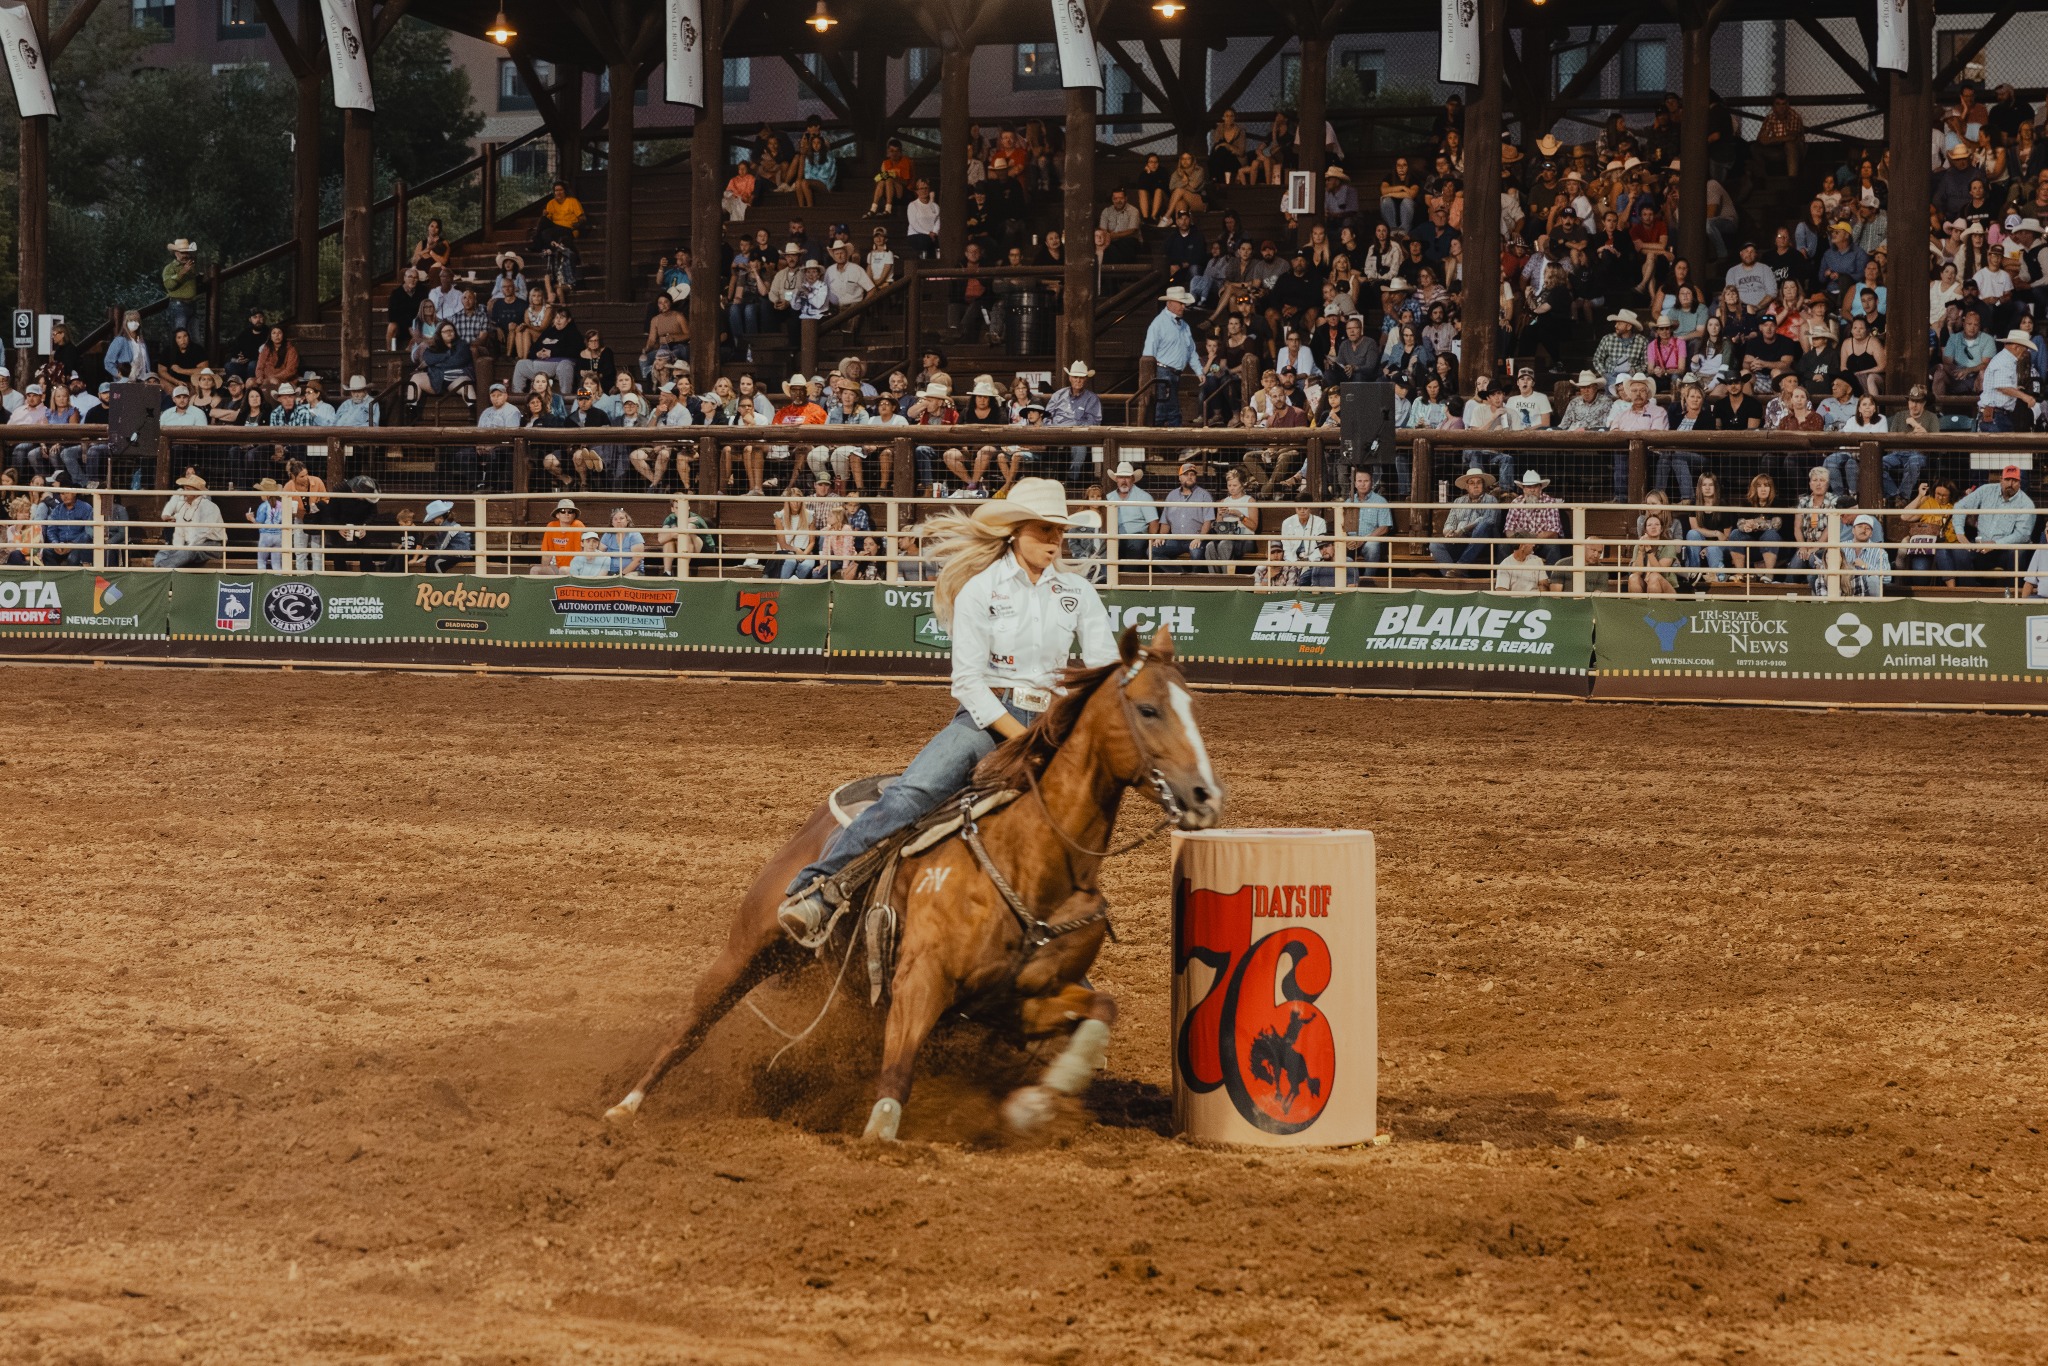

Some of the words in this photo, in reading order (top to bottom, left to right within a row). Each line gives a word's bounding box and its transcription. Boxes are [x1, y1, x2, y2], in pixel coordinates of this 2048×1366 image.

[0, 580, 62, 609] OTA
[271, 584, 318, 600] COWBOY
[415, 582, 510, 613] Rocksino
[559, 588, 586, 598] BUTTE
[587, 589, 622, 599] COUNTY
[624, 590, 674, 601] EQUIPMENT
[328, 597, 385, 606] OFFICIAL
[558, 602, 612, 612] AUTOMOTIVE
[613, 603, 655, 613] COMPANY
[656, 605, 674, 614] INC.
[328, 605, 384, 614] NETWORK
[1698, 610, 1759, 621] TRI-STATE
[66, 614, 139, 628] NEWSCENTER1
[270, 618, 316, 632] CHANNEL
[445, 621, 479, 629] DEADWOOD
[570, 615, 611, 624] LINDSKOV
[613, 616, 661, 626] IMPLEMENT
[736, 590, 779, 645] 76
[1373, 604, 1552, 640] BLAKE'S
[1689, 615, 1789, 634] LIVESTOCK
[1250, 631, 1277, 641] Black
[1277, 632, 1297, 642] Hills
[1297, 633, 1331, 646] Energy
[1882, 620, 1988, 649] MERCK
[1298, 644, 1326, 655] Ready
[1365, 637, 1429, 651] TRAILER
[1430, 638, 1480, 651] SALES
[1481, 640, 1494, 652] &
[1496, 641, 1555, 655] REPAIR
[1728, 634, 1789, 654] NEWS
[1650, 657, 1715, 666] WWW.TSLN.COM
[1736, 659, 1755, 667] (877)
[1883, 654, 1936, 667] Animal
[1940, 654, 1989, 669] Health
[1253, 885, 1307, 918] DAYS
[1309, 885, 1332, 918] OF
[1175, 878, 1335, 1136] 76
